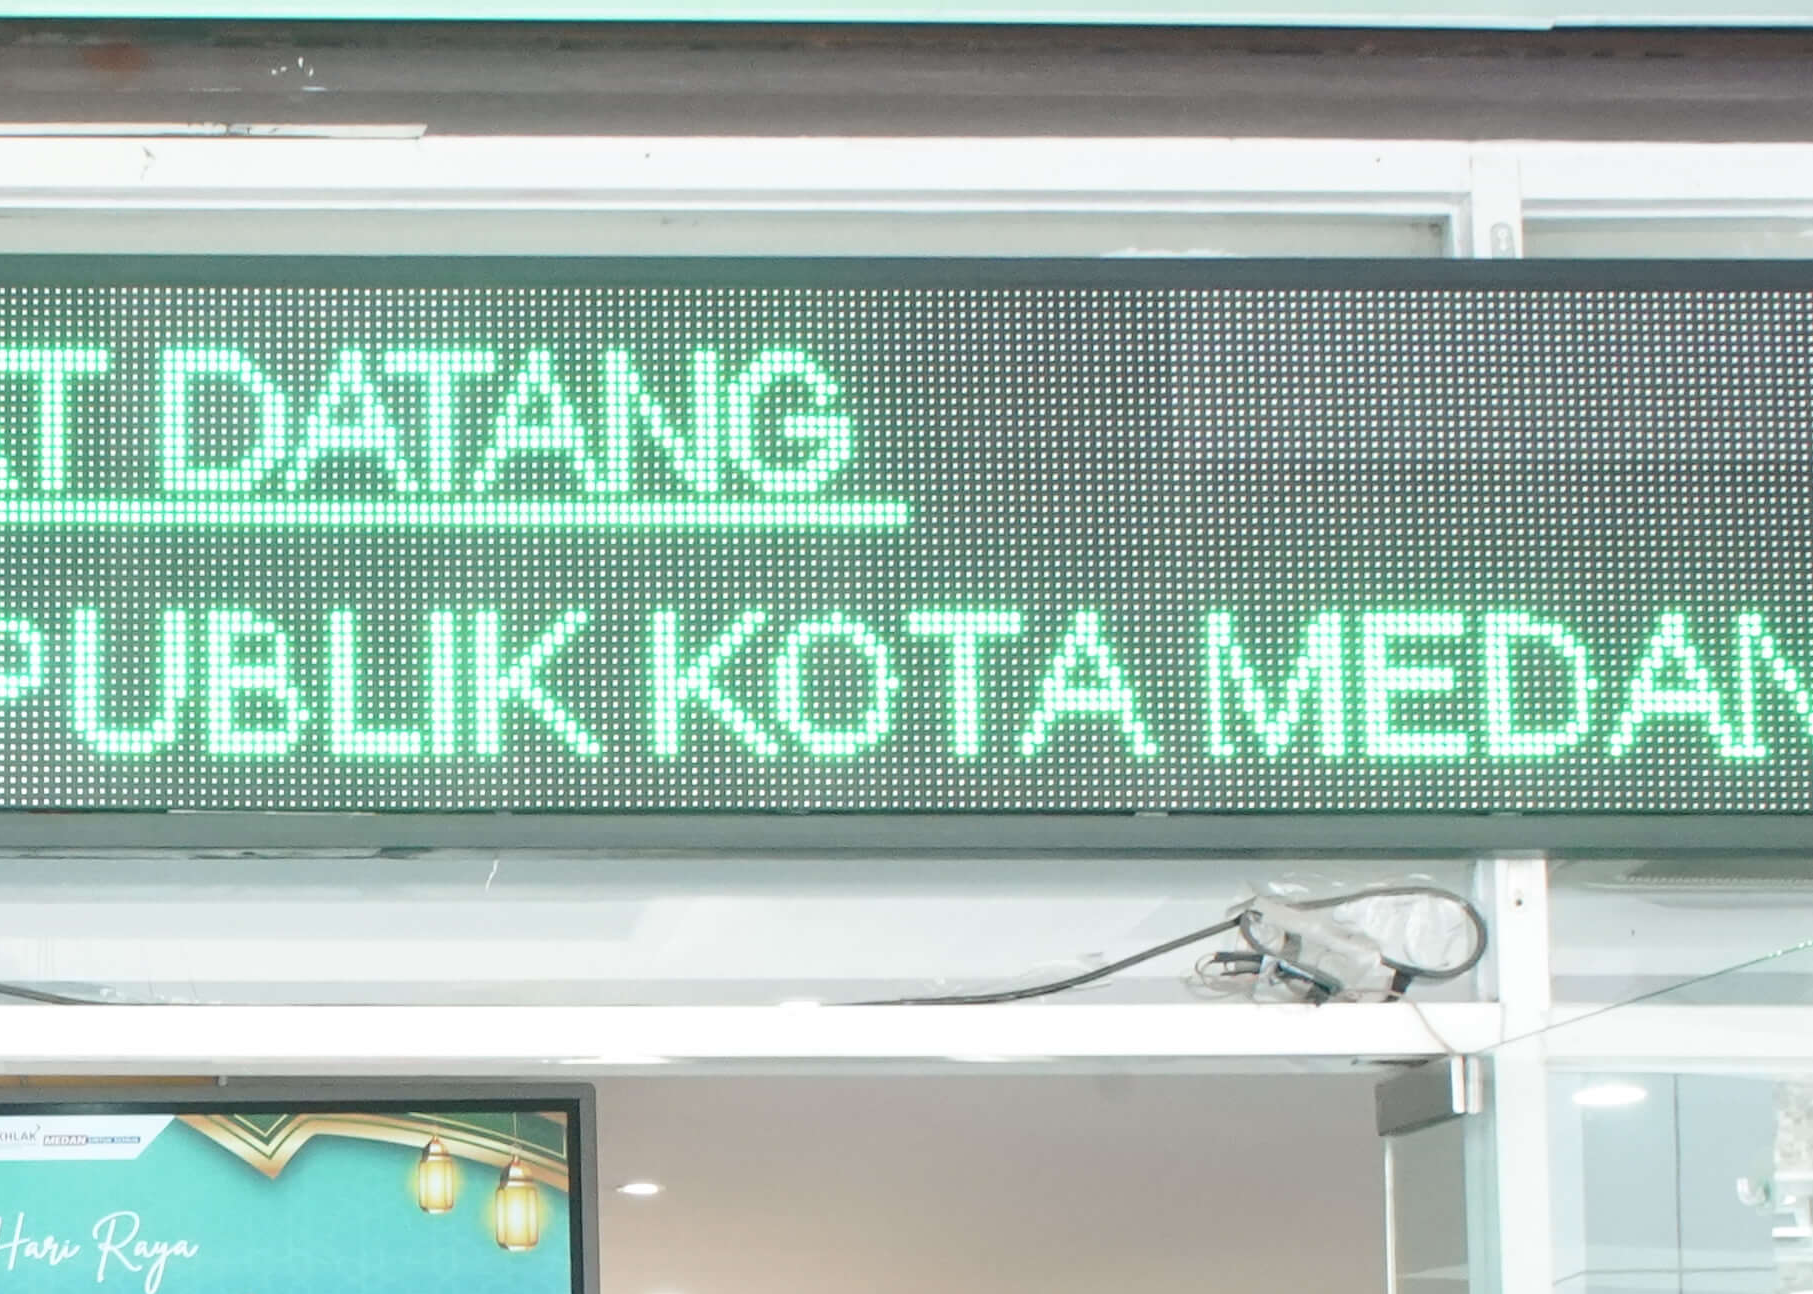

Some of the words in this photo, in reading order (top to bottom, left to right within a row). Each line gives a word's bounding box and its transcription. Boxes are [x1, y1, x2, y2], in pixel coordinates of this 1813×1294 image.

[158, 347, 855, 493] DATANG
[652, 607, 1161, 760] KOTA
[1205, 608, 1813, 761] MEDAN
